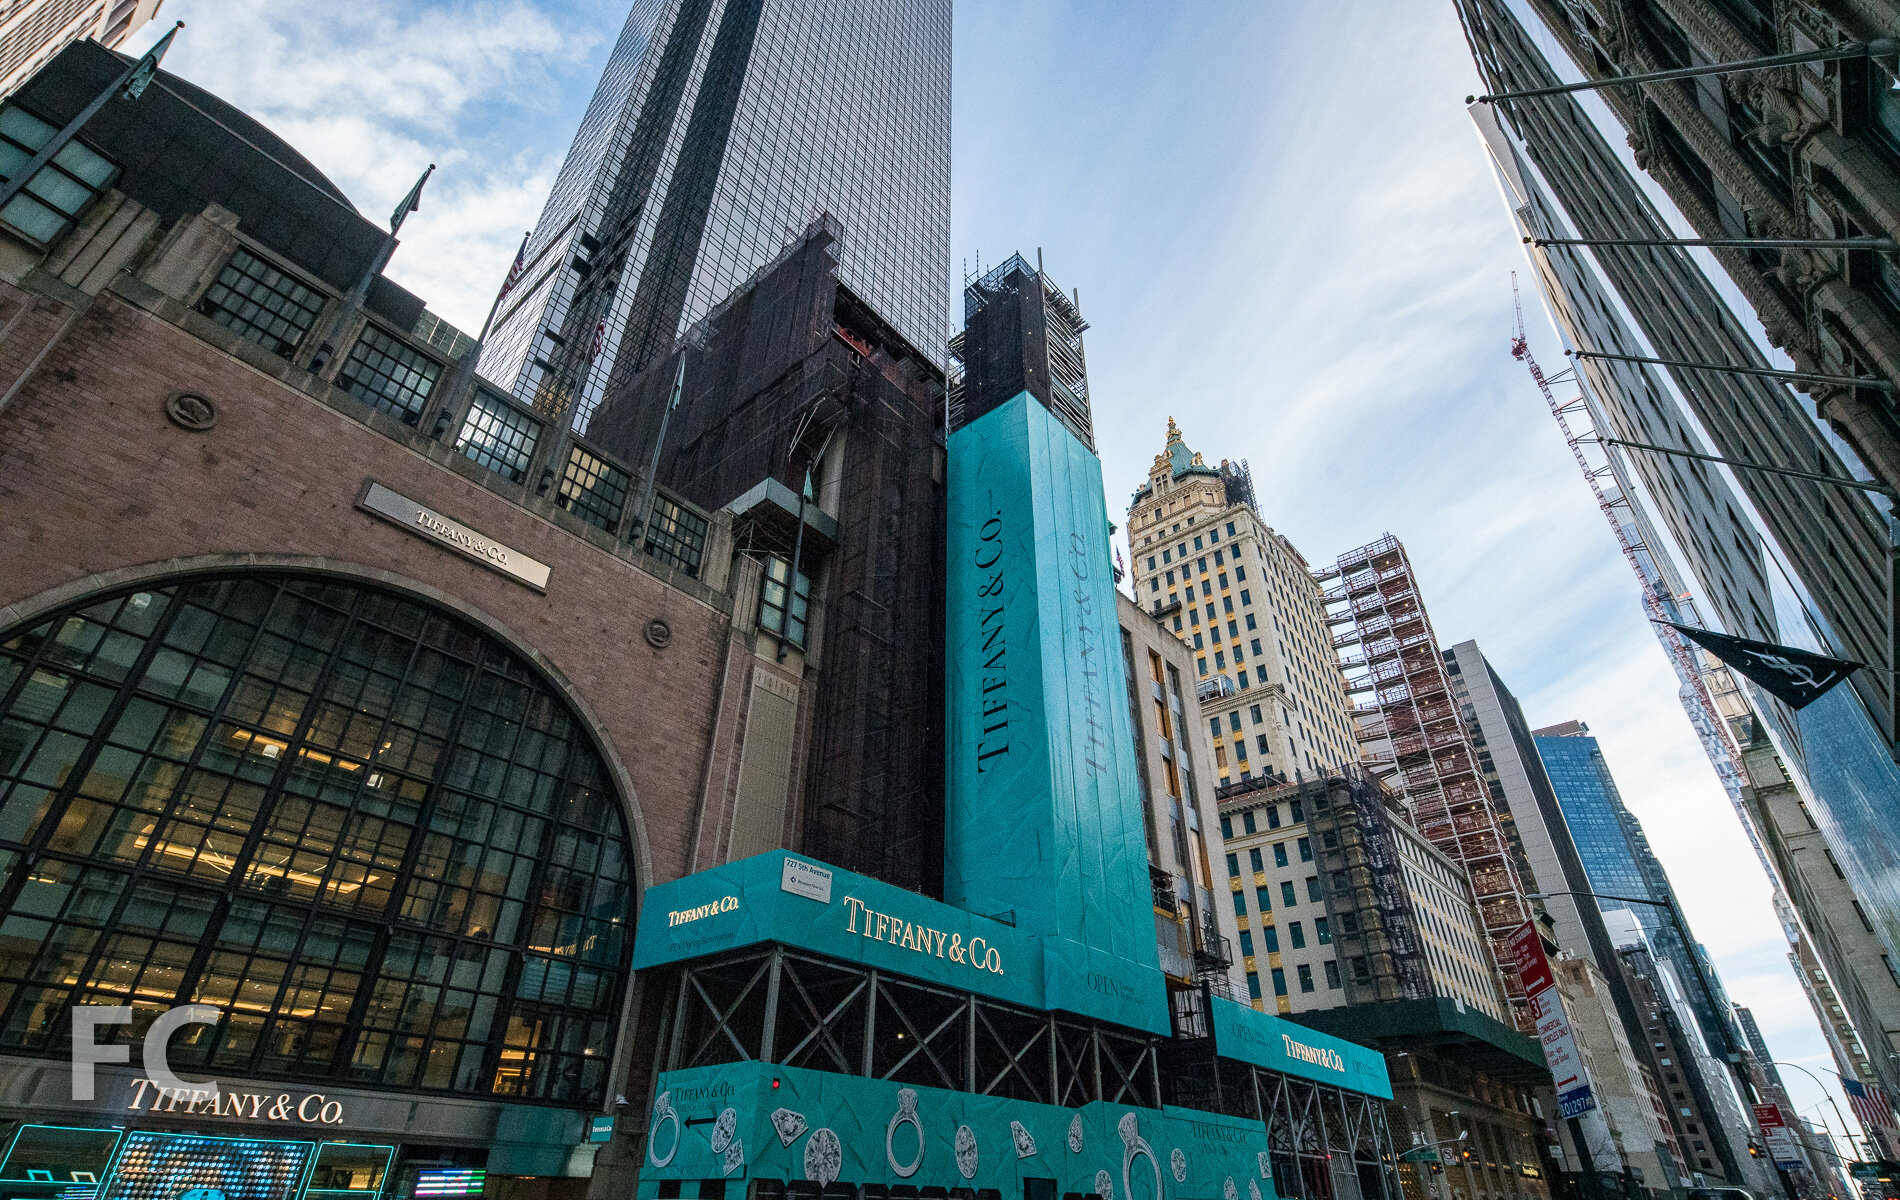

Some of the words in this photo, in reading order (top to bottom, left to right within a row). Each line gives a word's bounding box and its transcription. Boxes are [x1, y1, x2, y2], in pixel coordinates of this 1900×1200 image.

[977, 605, 1009, 775] TIFFANY
[786, 859, 798, 869] 727
[808, 866, 831, 880] Avenue
[843, 895, 948, 959] TIFFANY
[1531, 1000, 1540, 1018] 3
[127, 1078, 272, 1119] TIFFANY
